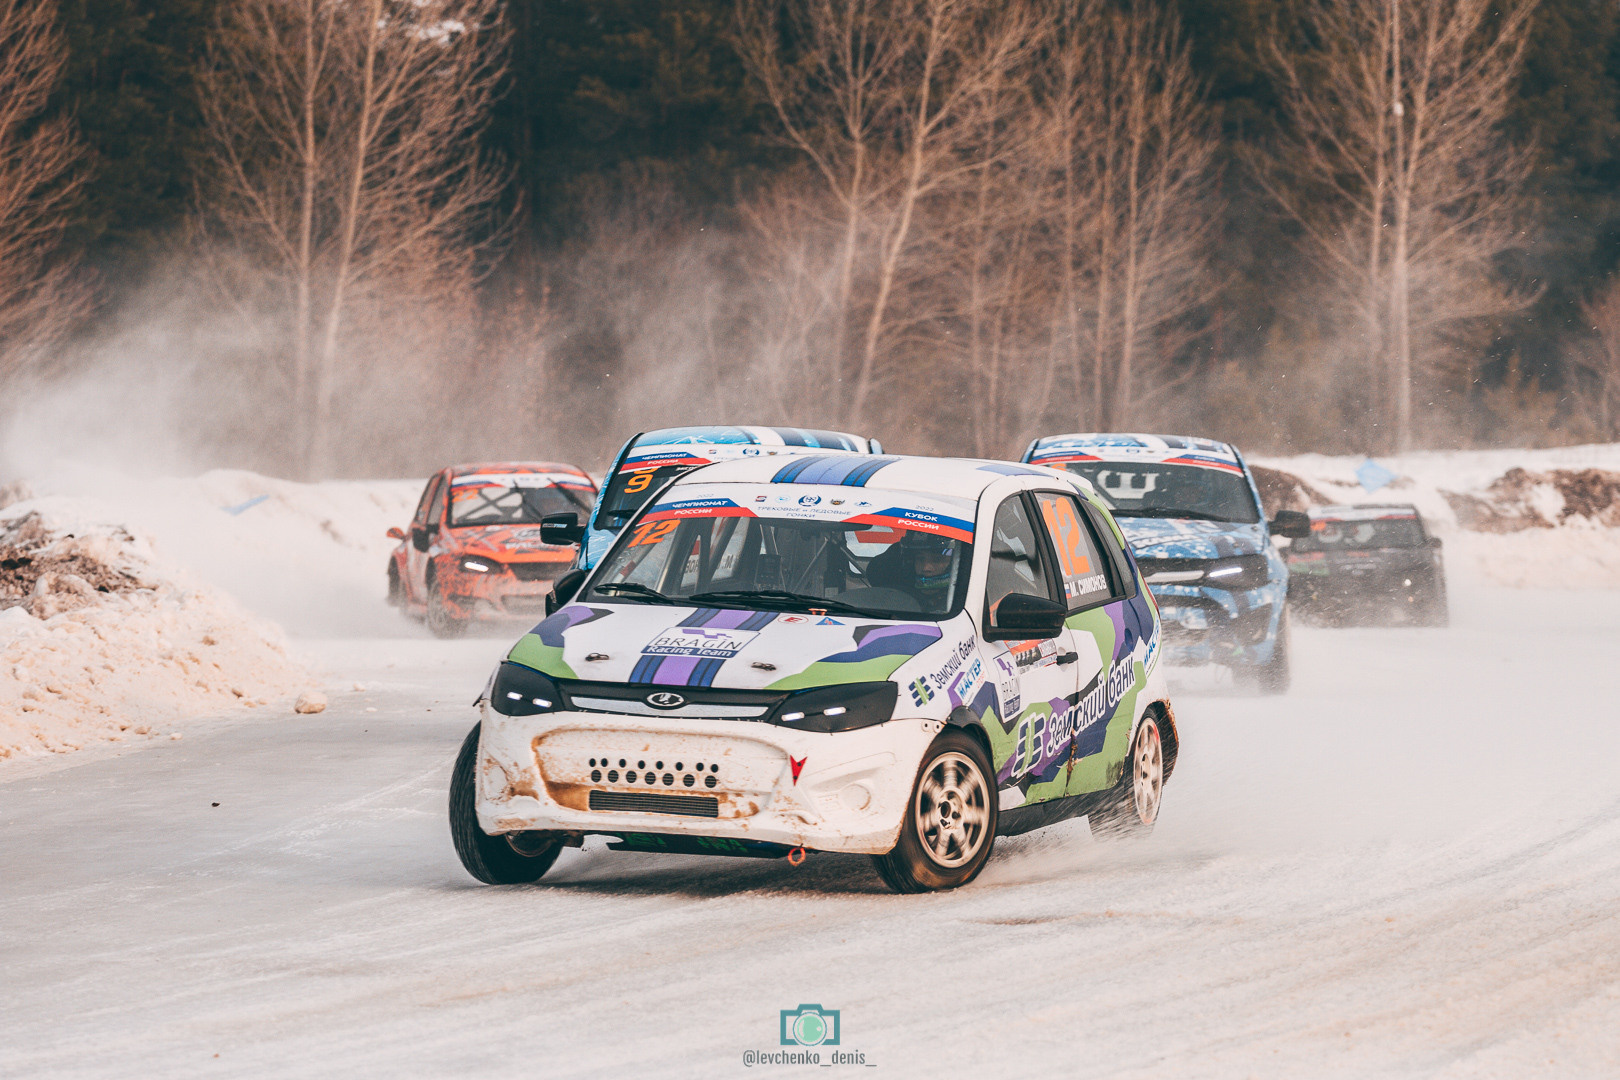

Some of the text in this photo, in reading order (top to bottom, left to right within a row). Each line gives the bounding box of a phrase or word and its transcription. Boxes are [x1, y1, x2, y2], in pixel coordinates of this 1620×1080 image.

[624, 474, 653, 494] 9
[897, 519, 940, 530] РОССИИ
[904, 511, 938, 522] КУБОК
[627, 520, 681, 548] 12
[1042, 497, 1090, 577] 12
[1077, 574, 1108, 596] СИМОНОВ
[646, 645, 732, 657] Racing Team
[930, 648, 962, 690] Земский
[959, 634, 977, 661] банк
[957, 657, 981, 699] МАСТЕР
[1047, 656, 1135, 755] Земский банк
